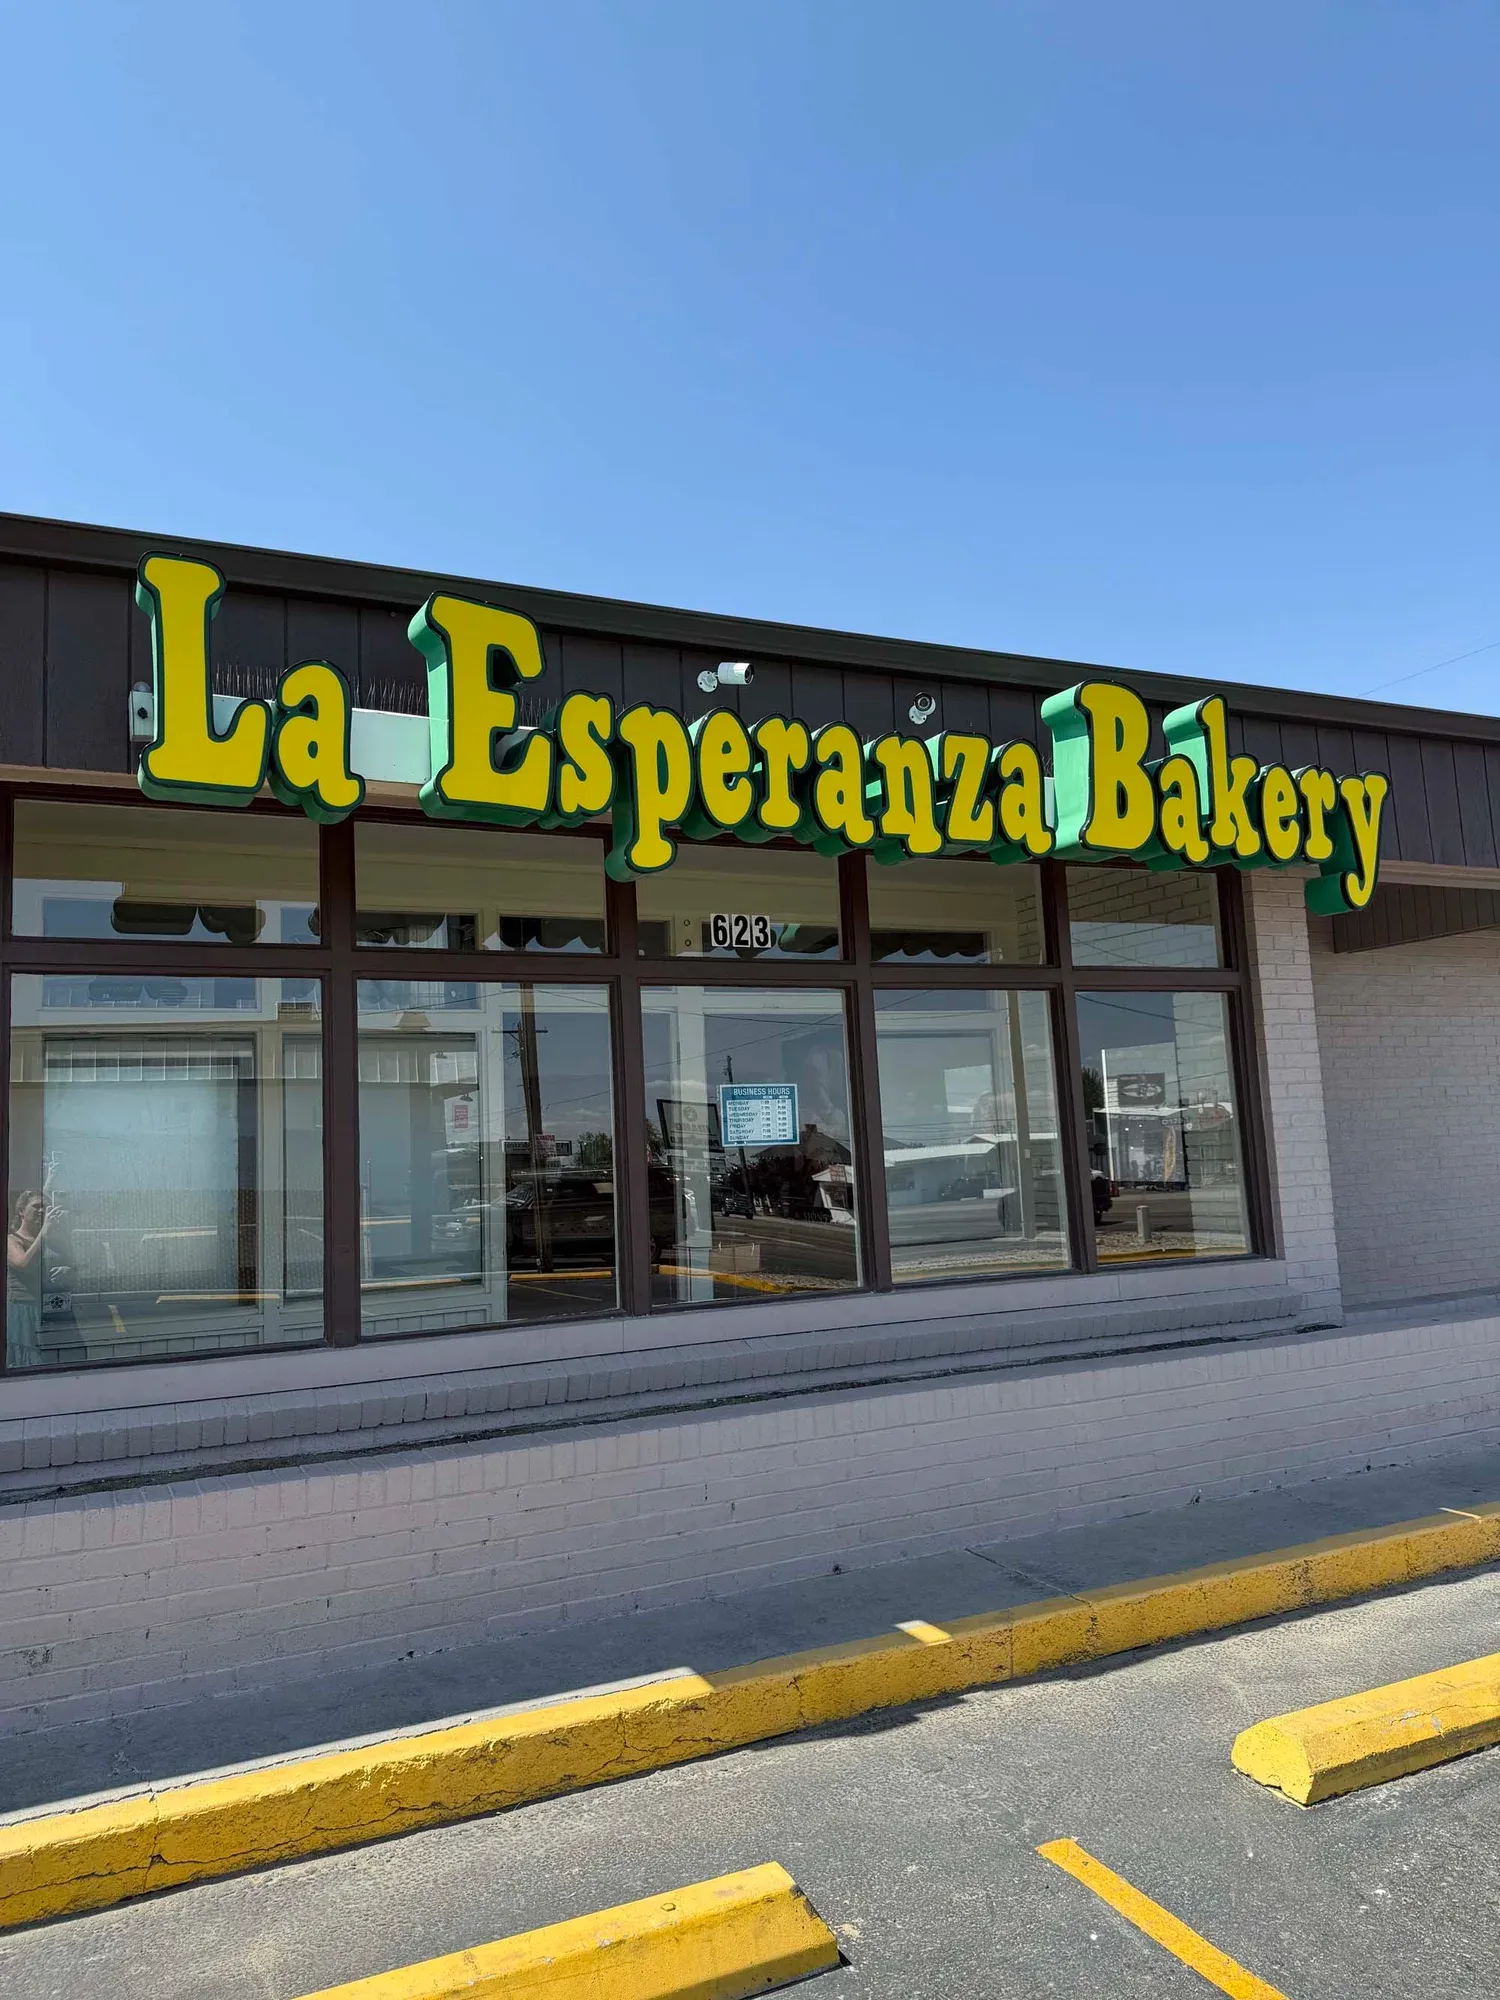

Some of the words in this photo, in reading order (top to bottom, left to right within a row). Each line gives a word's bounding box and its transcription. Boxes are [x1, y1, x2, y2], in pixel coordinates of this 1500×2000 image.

[137, 551, 366, 814] La
[418, 591, 1055, 876] Esperanza
[1066, 679, 1390, 912] Bakery
[712, 914, 769, 947] 623
[733, 1087, 767, 1096] BUSINESS
[767, 1087, 790, 1095] HOURS
